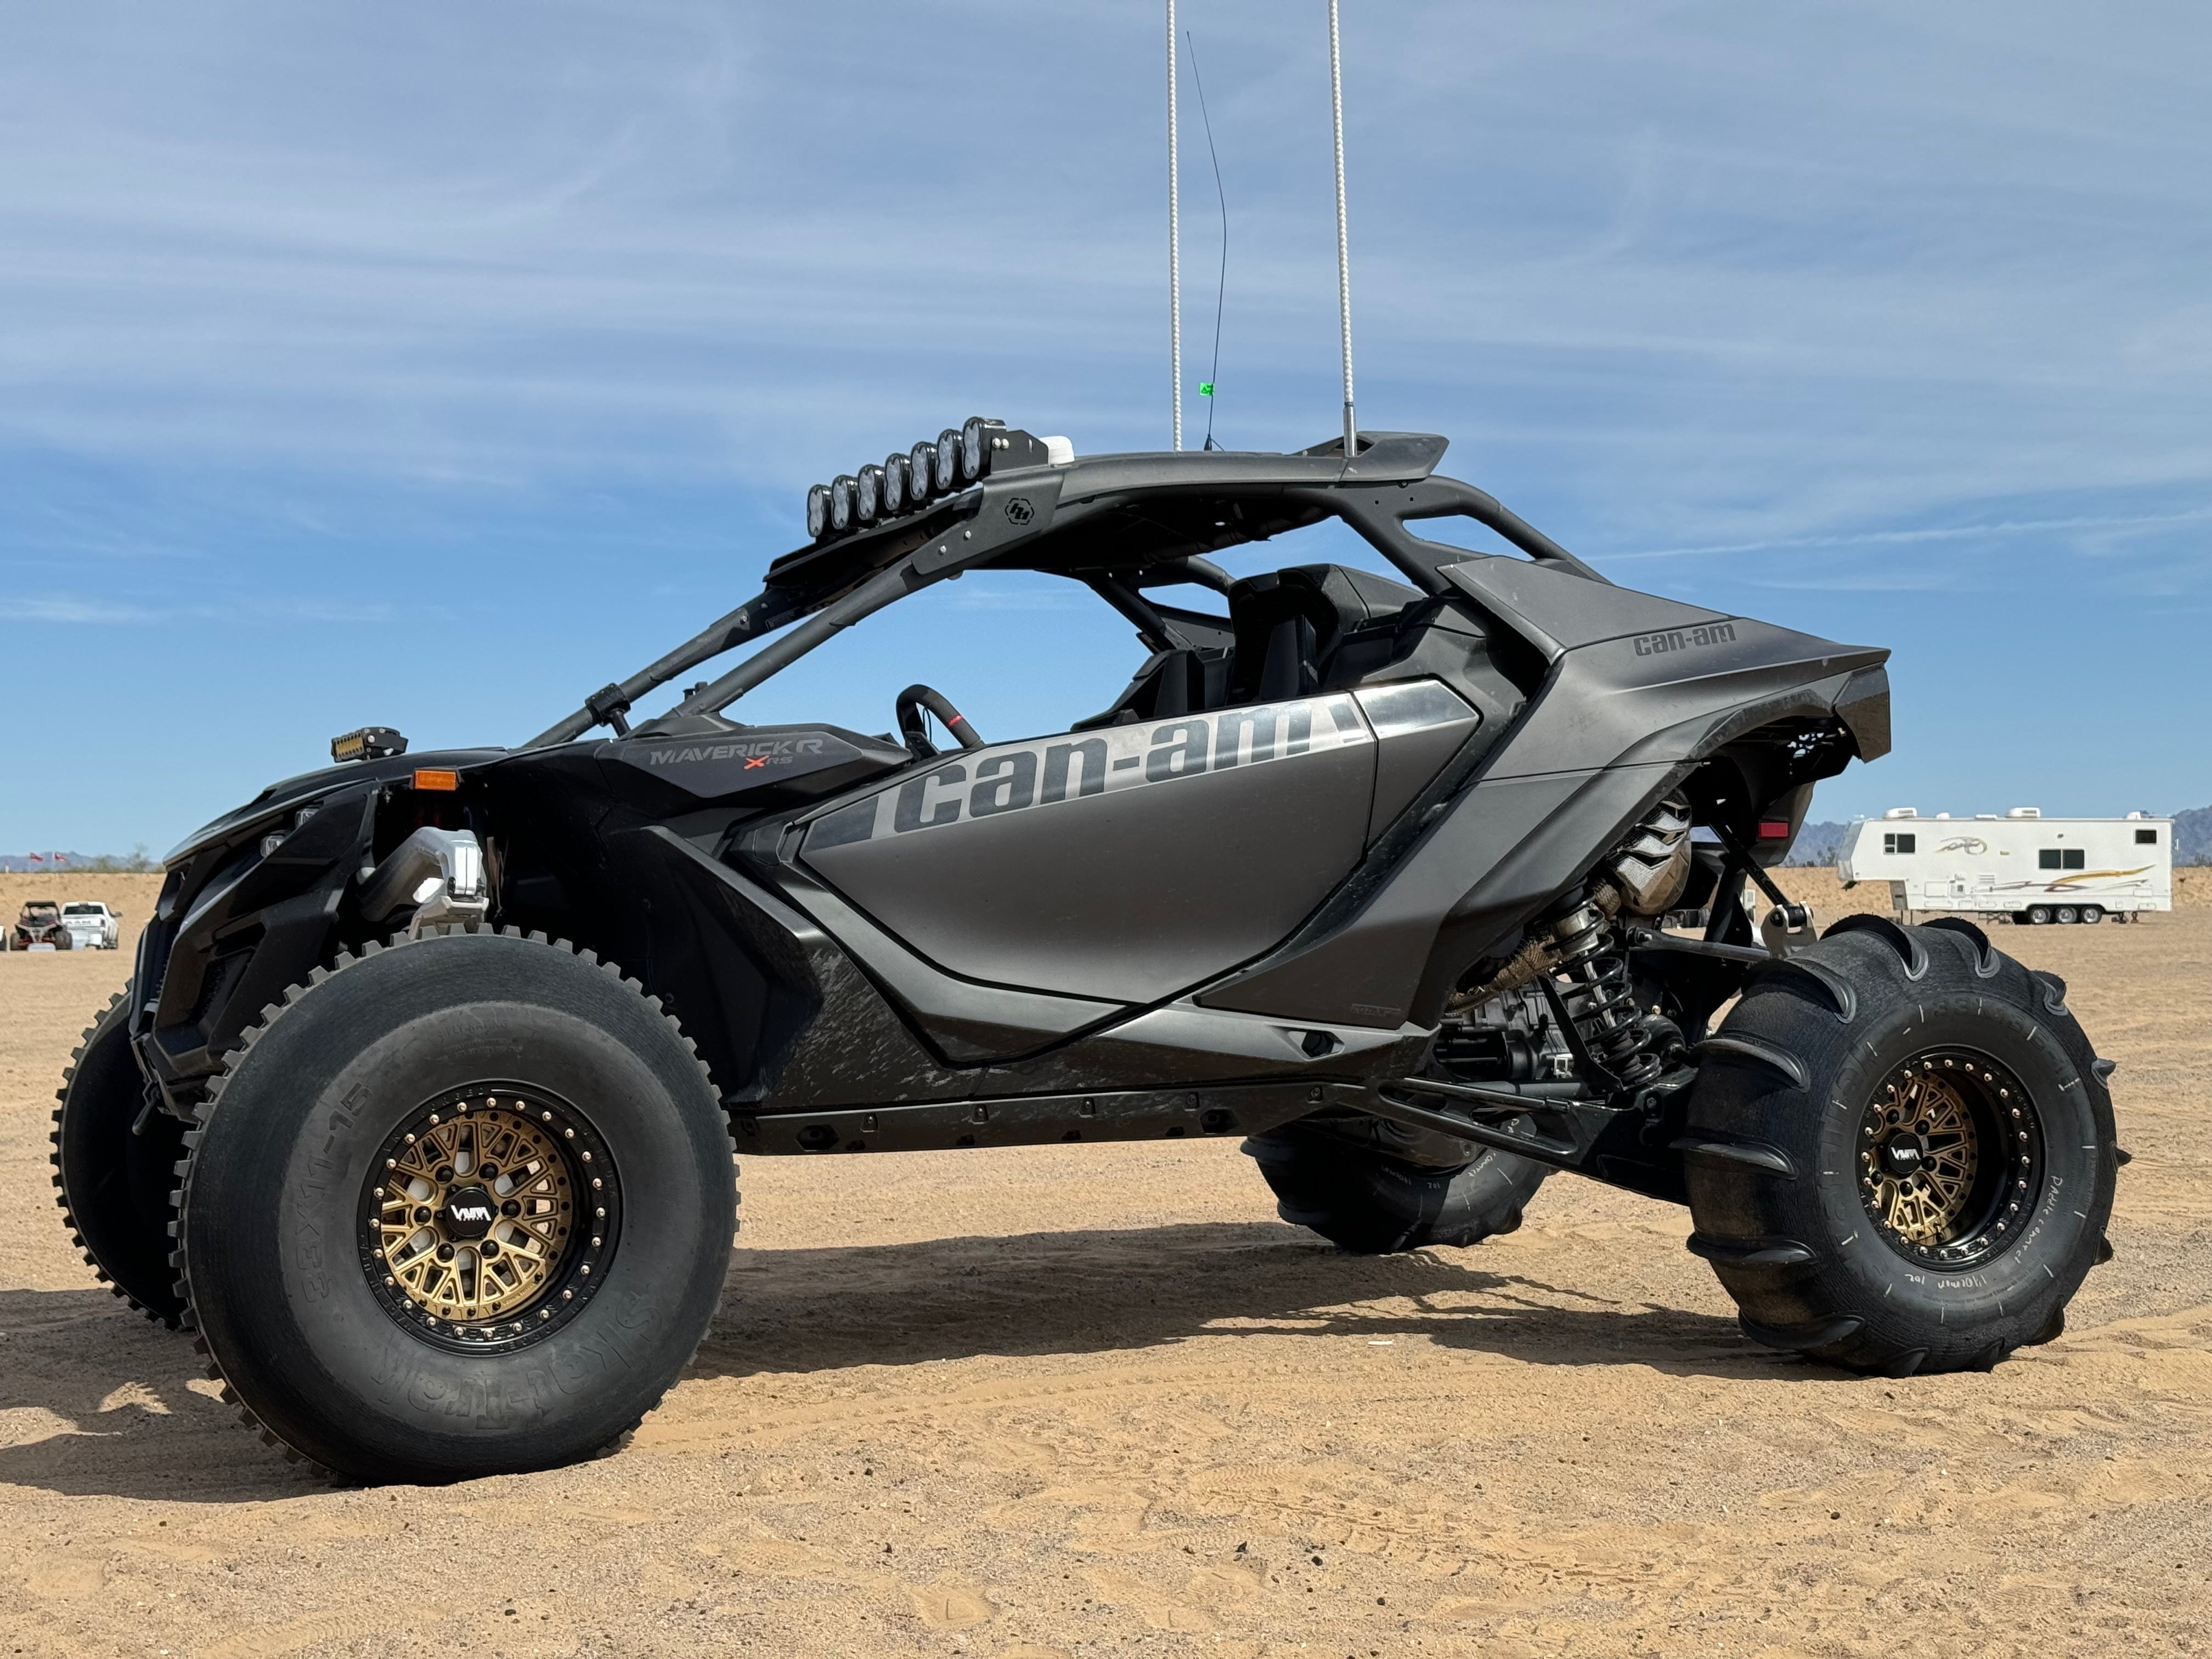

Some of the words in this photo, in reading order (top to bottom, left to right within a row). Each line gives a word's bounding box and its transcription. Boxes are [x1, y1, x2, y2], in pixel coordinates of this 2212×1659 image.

[1633, 623, 1736, 656] can-am
[650, 741, 793, 766] MAVERICK
[795, 738, 823, 754] R
[894, 700, 1311, 833] can-am
[294, 1080, 374, 1305] 33X11-15
